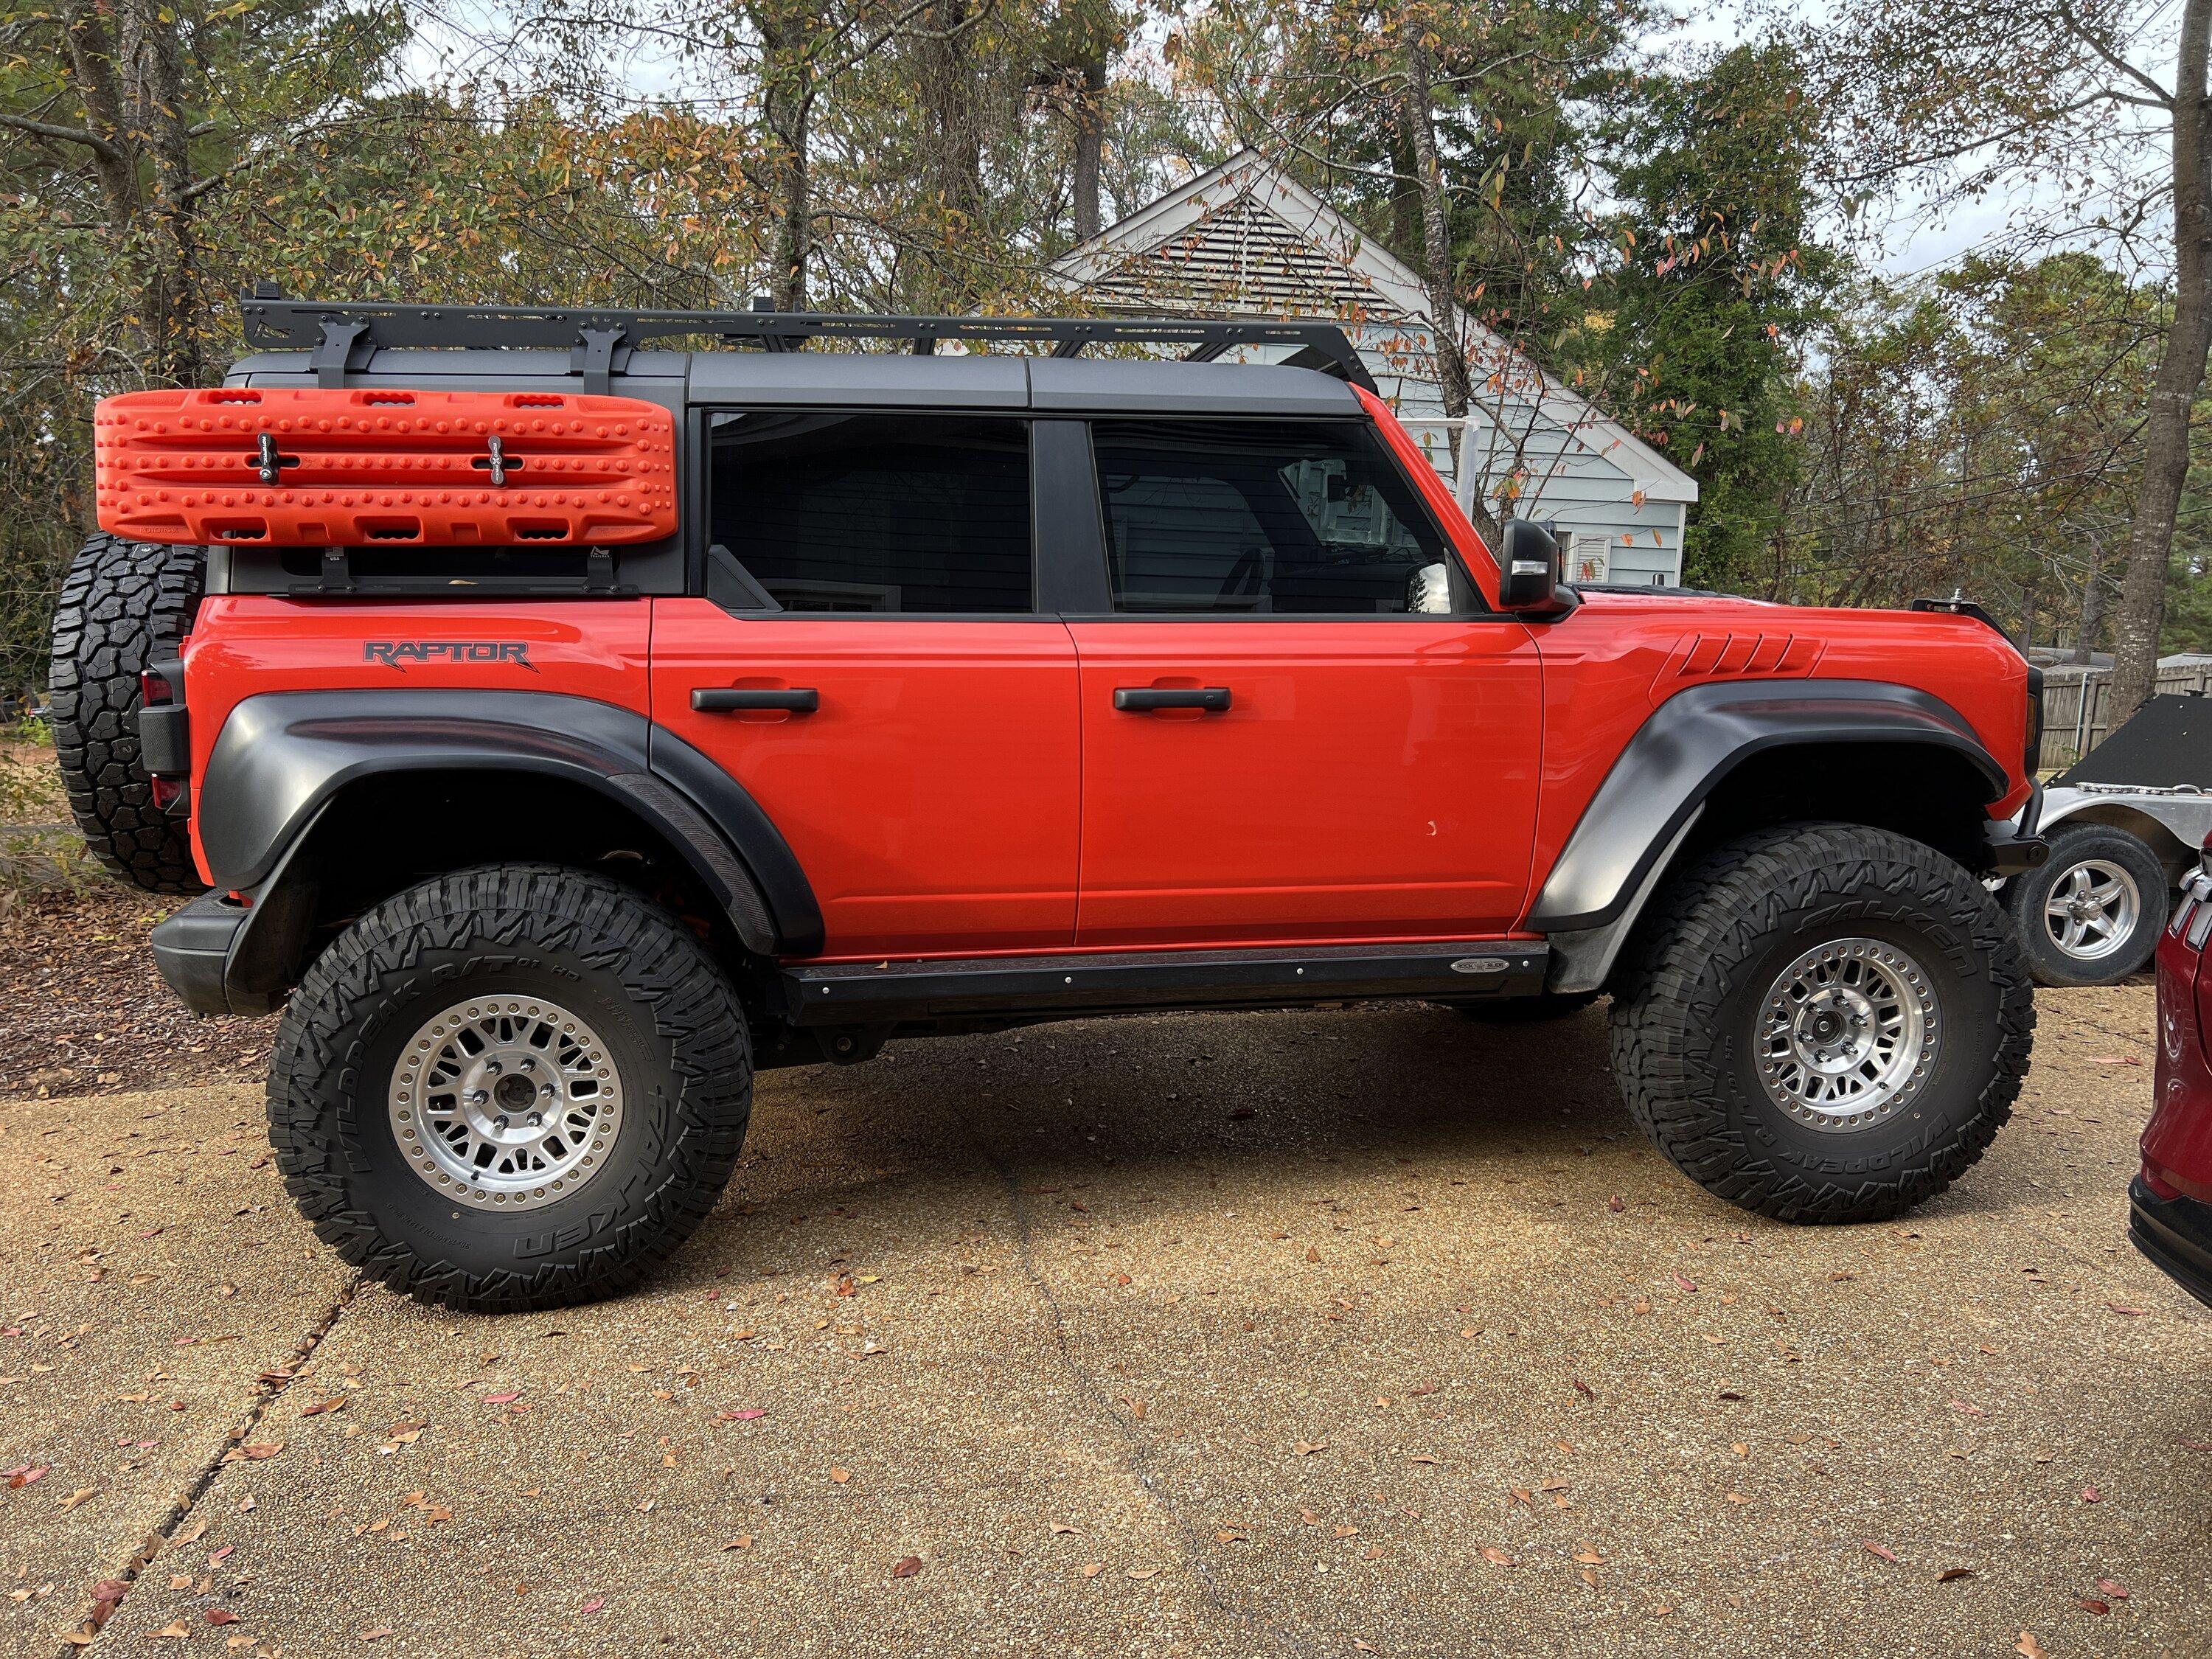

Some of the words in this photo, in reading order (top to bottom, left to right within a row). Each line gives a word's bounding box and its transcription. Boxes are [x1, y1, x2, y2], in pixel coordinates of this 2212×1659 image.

[363, 641, 541, 674] RAPTOR
[336, 977, 422, 1172] WILDPEAK
[512, 1084, 669, 1260] FALKEN
[1776, 1111, 1951, 1175] WILDPEAK
